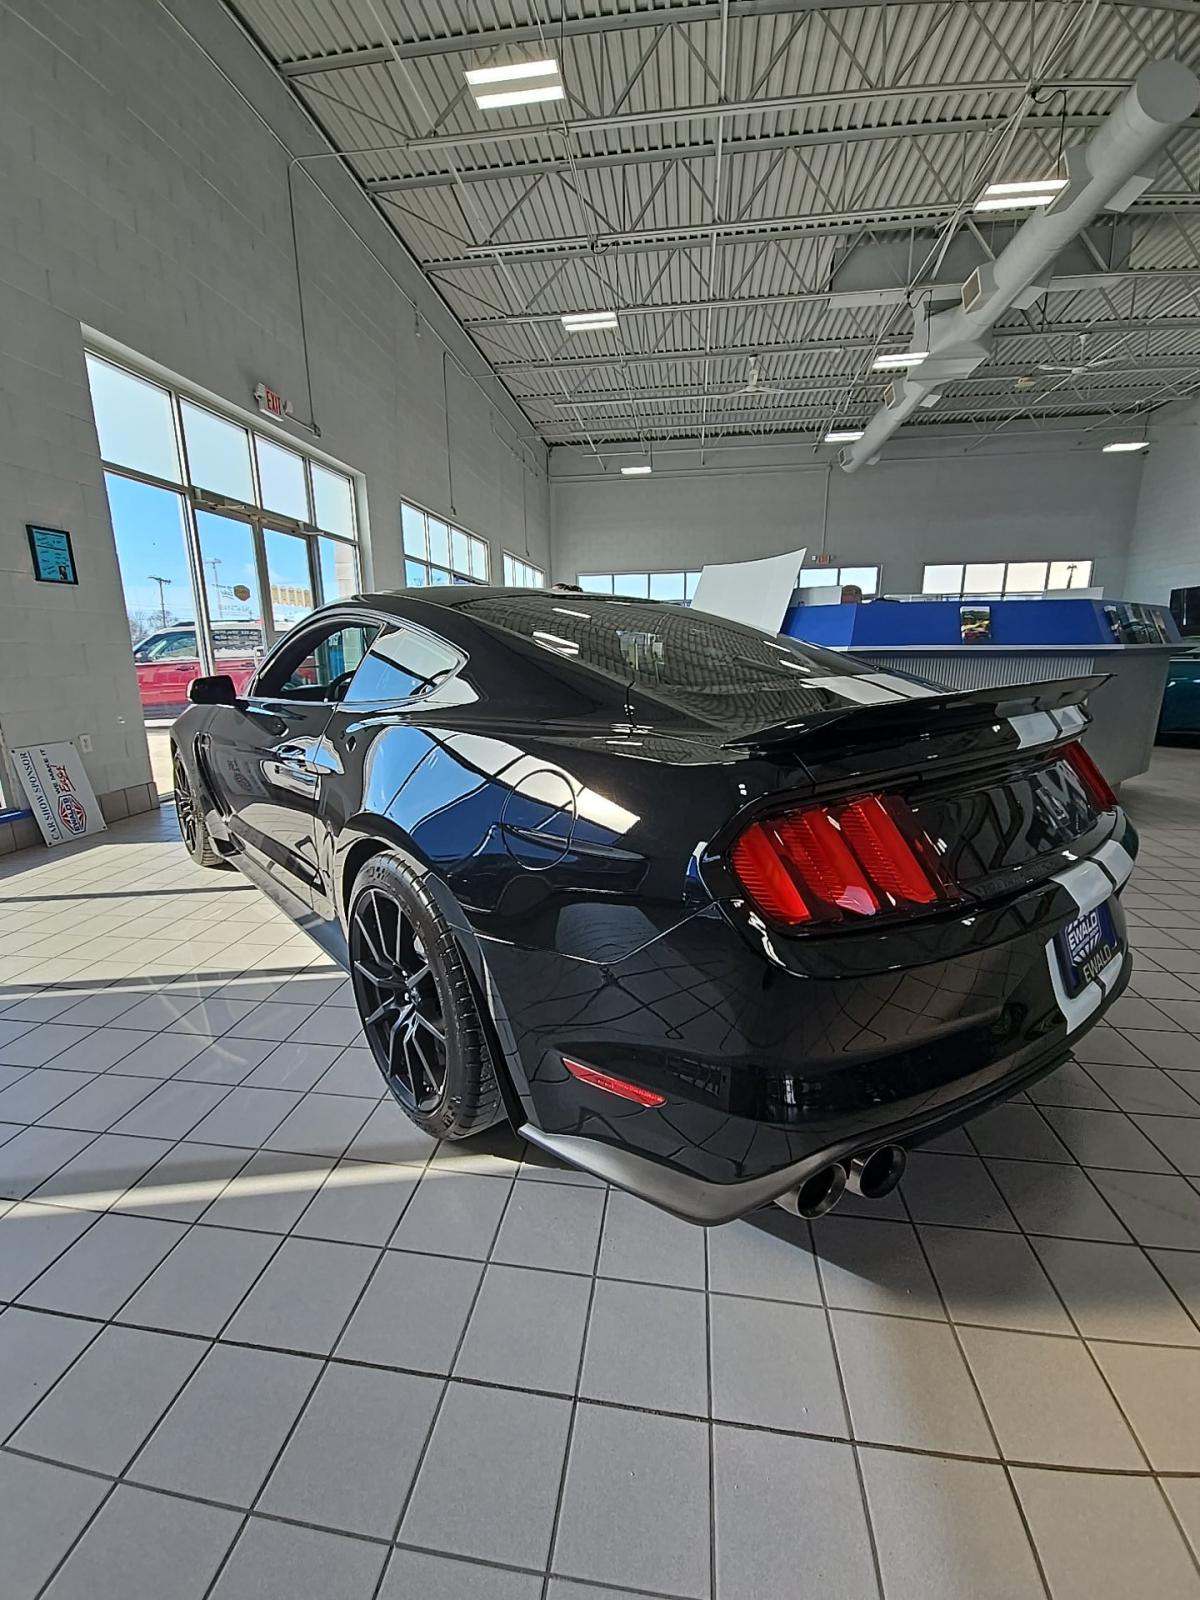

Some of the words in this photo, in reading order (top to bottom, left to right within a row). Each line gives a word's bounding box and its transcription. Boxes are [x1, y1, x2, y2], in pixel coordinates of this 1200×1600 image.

[266, 391, 282, 415] EXIT
[20, 752, 41, 793] SPONSOR
[43, 758, 57, 780] MAKE
[53, 782, 61, 794] WE
[36, 794, 52, 821] SHOW
[47, 821, 60, 840] CAR
[1068, 912, 1098, 950] EWALD
[1083, 945, 1112, 983] EWALD
